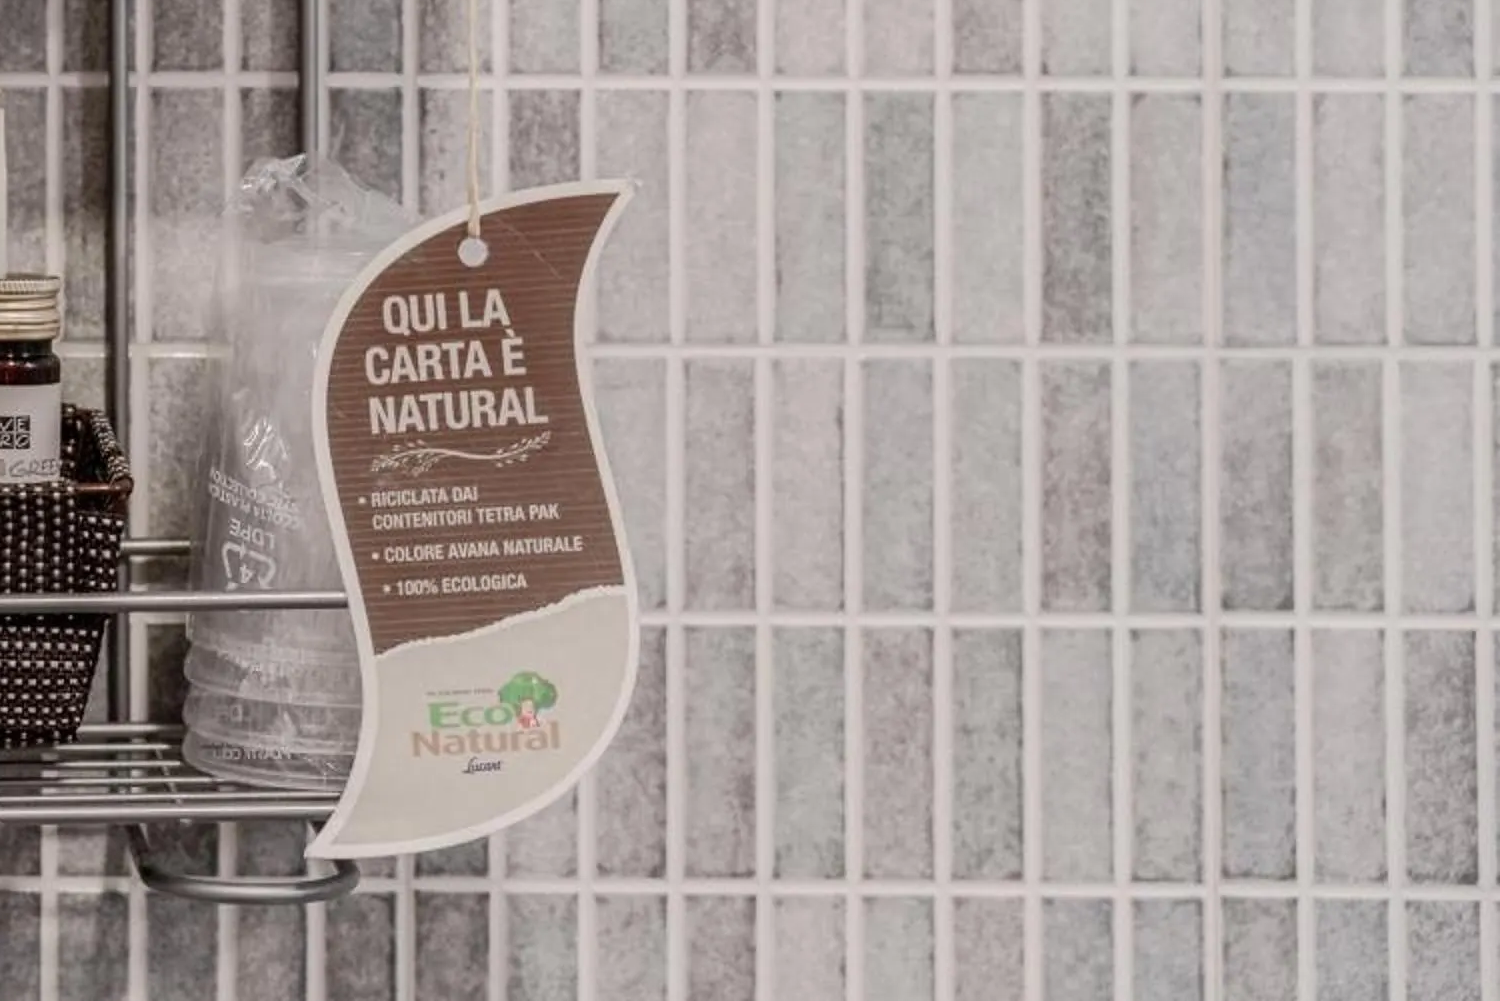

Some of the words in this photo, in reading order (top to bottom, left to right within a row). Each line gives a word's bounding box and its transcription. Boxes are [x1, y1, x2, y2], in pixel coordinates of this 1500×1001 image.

[382, 292, 448, 336] QUI
[458, 288, 511, 328] LA
[365, 340, 493, 385] CARTA
[501, 329, 527, 376] È
[368, 386, 549, 435] NATURAL
[371, 488, 449, 508] RICICLATA
[452, 486, 479, 503] DAI
[372, 509, 473, 530] CONTENITORI
[476, 506, 526, 524] TETRA
[529, 503, 561, 520] PAK
[229, 518, 275, 549] LDPE
[384, 544, 445, 563] COLORE
[447, 540, 500, 559] AVANA
[503, 535, 584, 556] NATURALE
[239, 564, 256, 584] 4
[396, 579, 439, 596] 100%
[442, 573, 528, 594] ECOLOGICA
[411, 720, 561, 758] Natural
